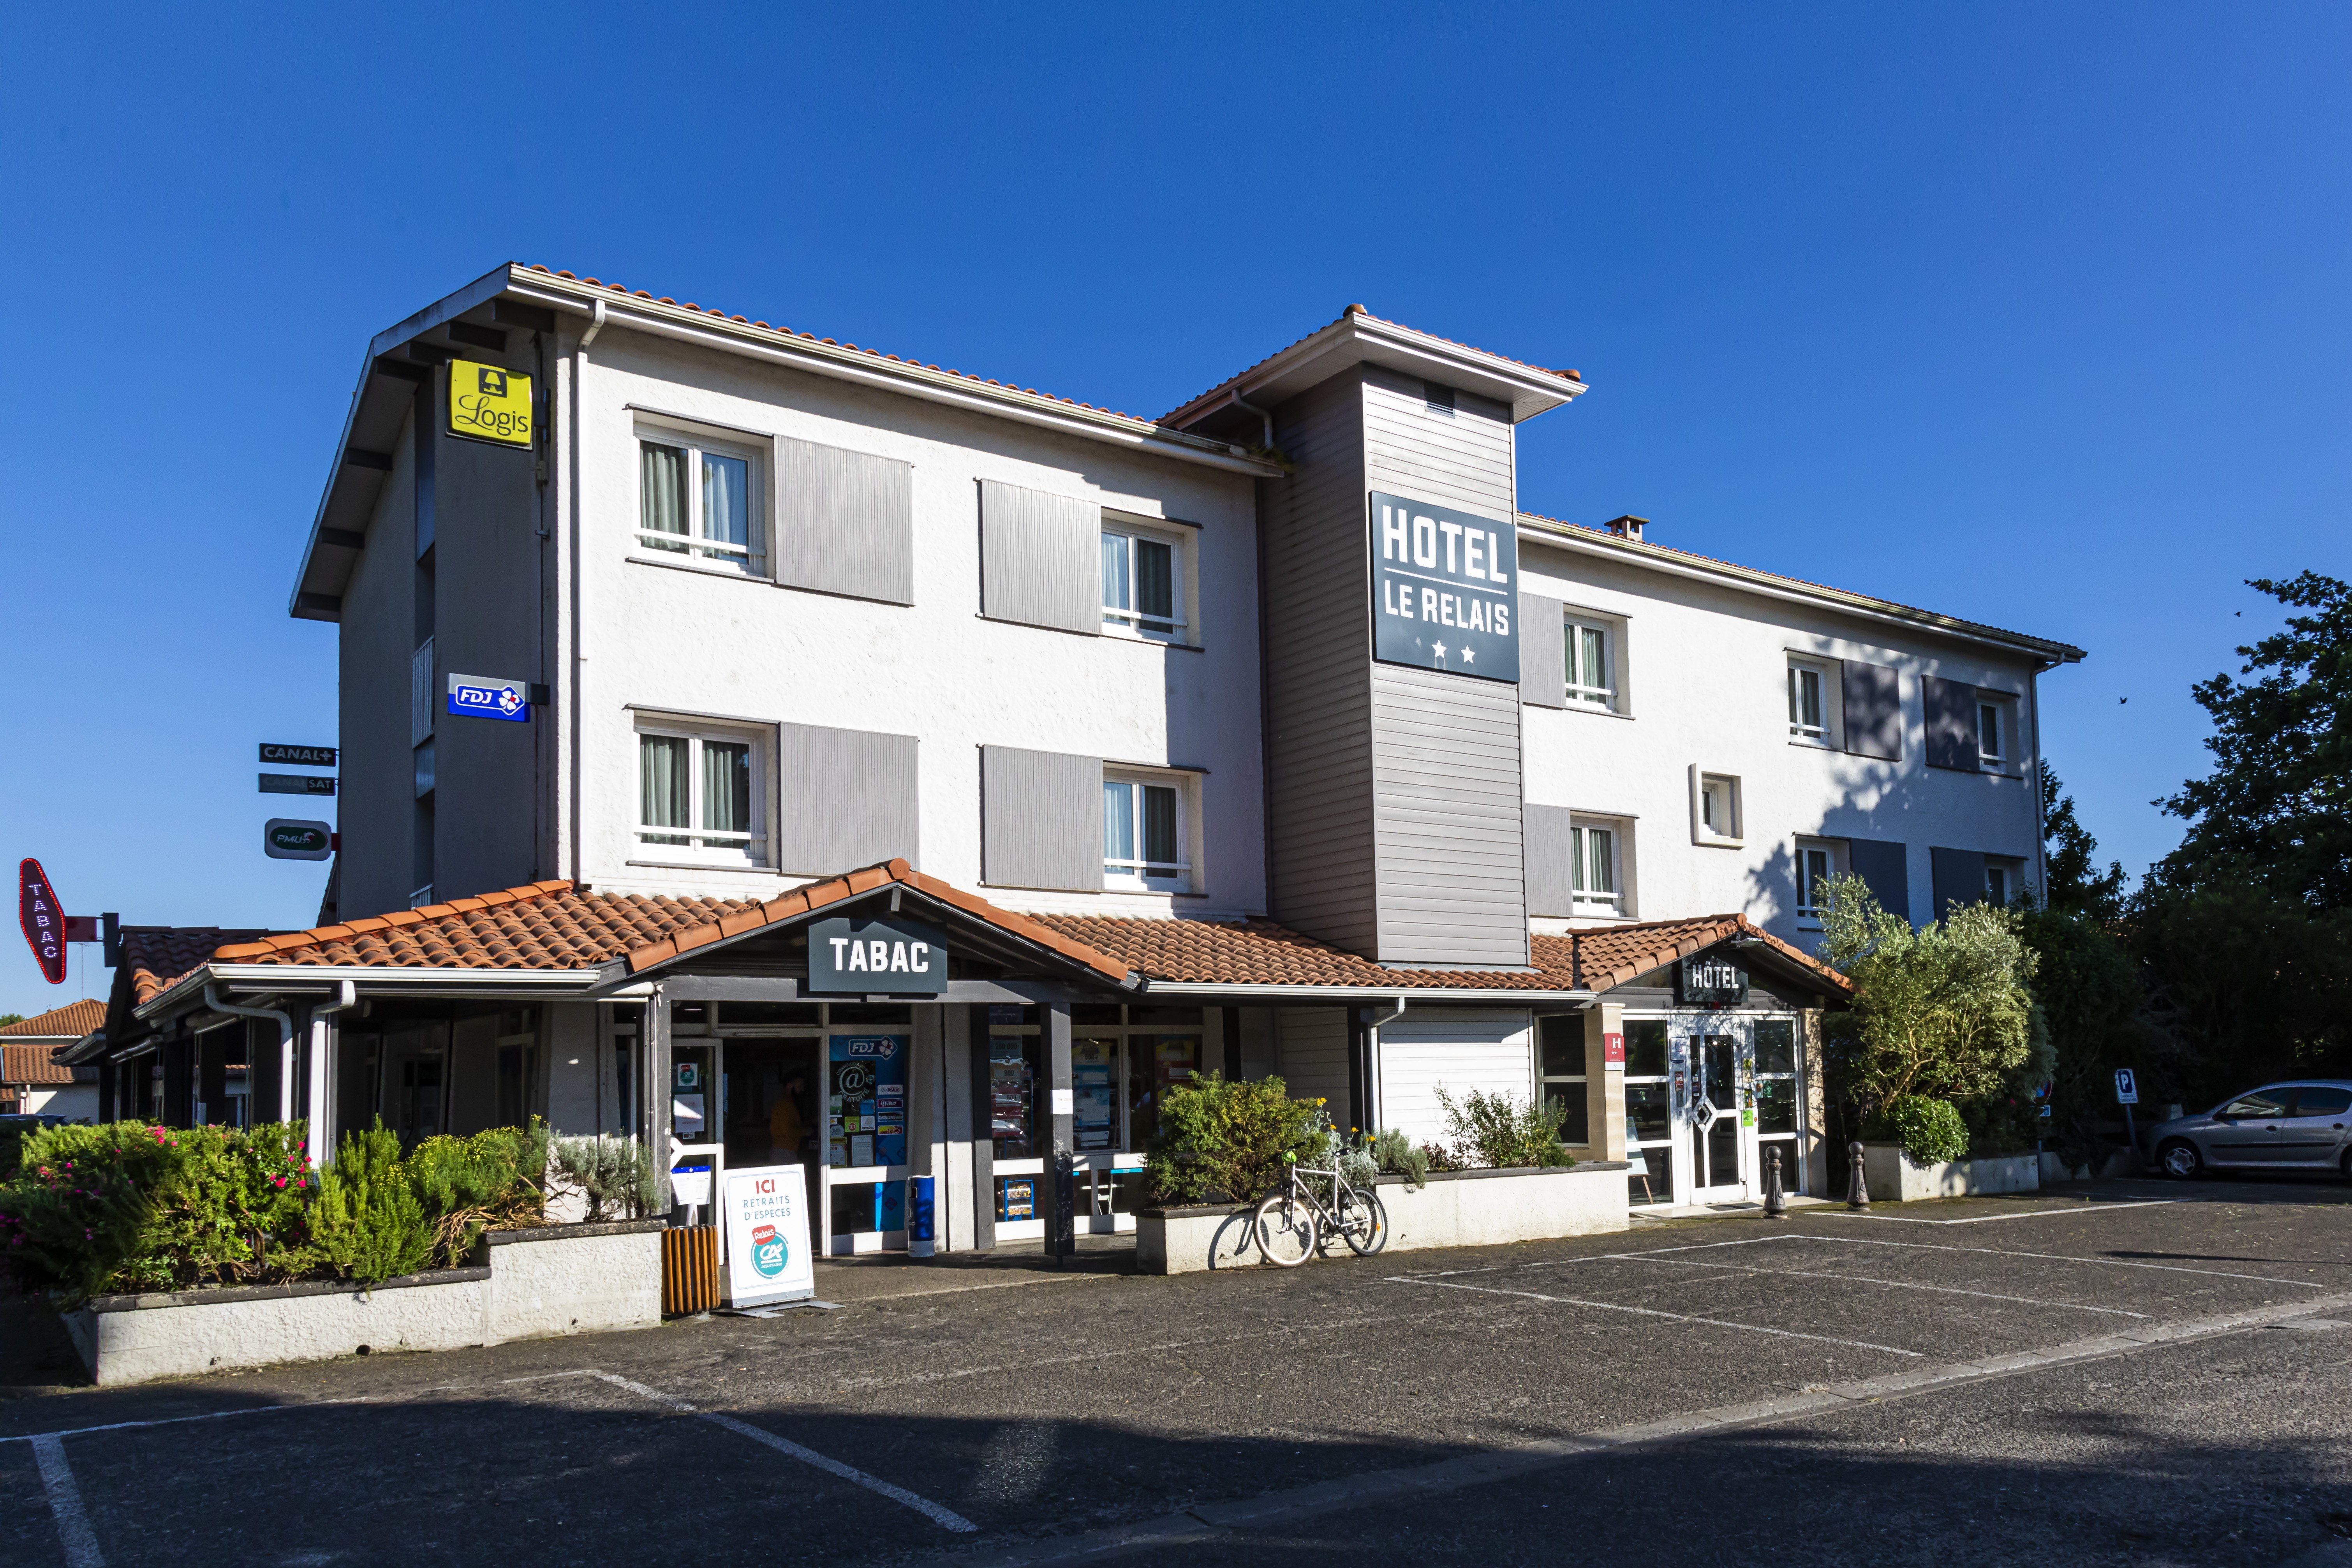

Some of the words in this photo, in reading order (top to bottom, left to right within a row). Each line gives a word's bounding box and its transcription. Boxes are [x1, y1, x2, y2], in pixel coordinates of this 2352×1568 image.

[455, 395, 528, 436] Logis
[1382, 505, 1508, 584] HOTEL
[1385, 579, 1414, 618] LE
[1422, 587, 1509, 636] RELAIS
[460, 689, 492, 704] FDJ
[264, 747, 332, 761] CANAL+
[276, 834, 302, 844] PMU
[28, 883, 58, 958] TABAC
[829, 937, 928, 973] TABAC
[1692, 961, 1739, 989] HÔTEL
[852, 1043, 875, 1052] FDJ
[1612, 1037, 1622, 1048] H
[2121, 1074, 2128, 1090] P
[756, 1179, 775, 1194] ICI
[743, 1196, 790, 1208] RETRAITS
[744, 1207, 791, 1220] D'ESPÈCES
[754, 1228, 775, 1240] Relais
